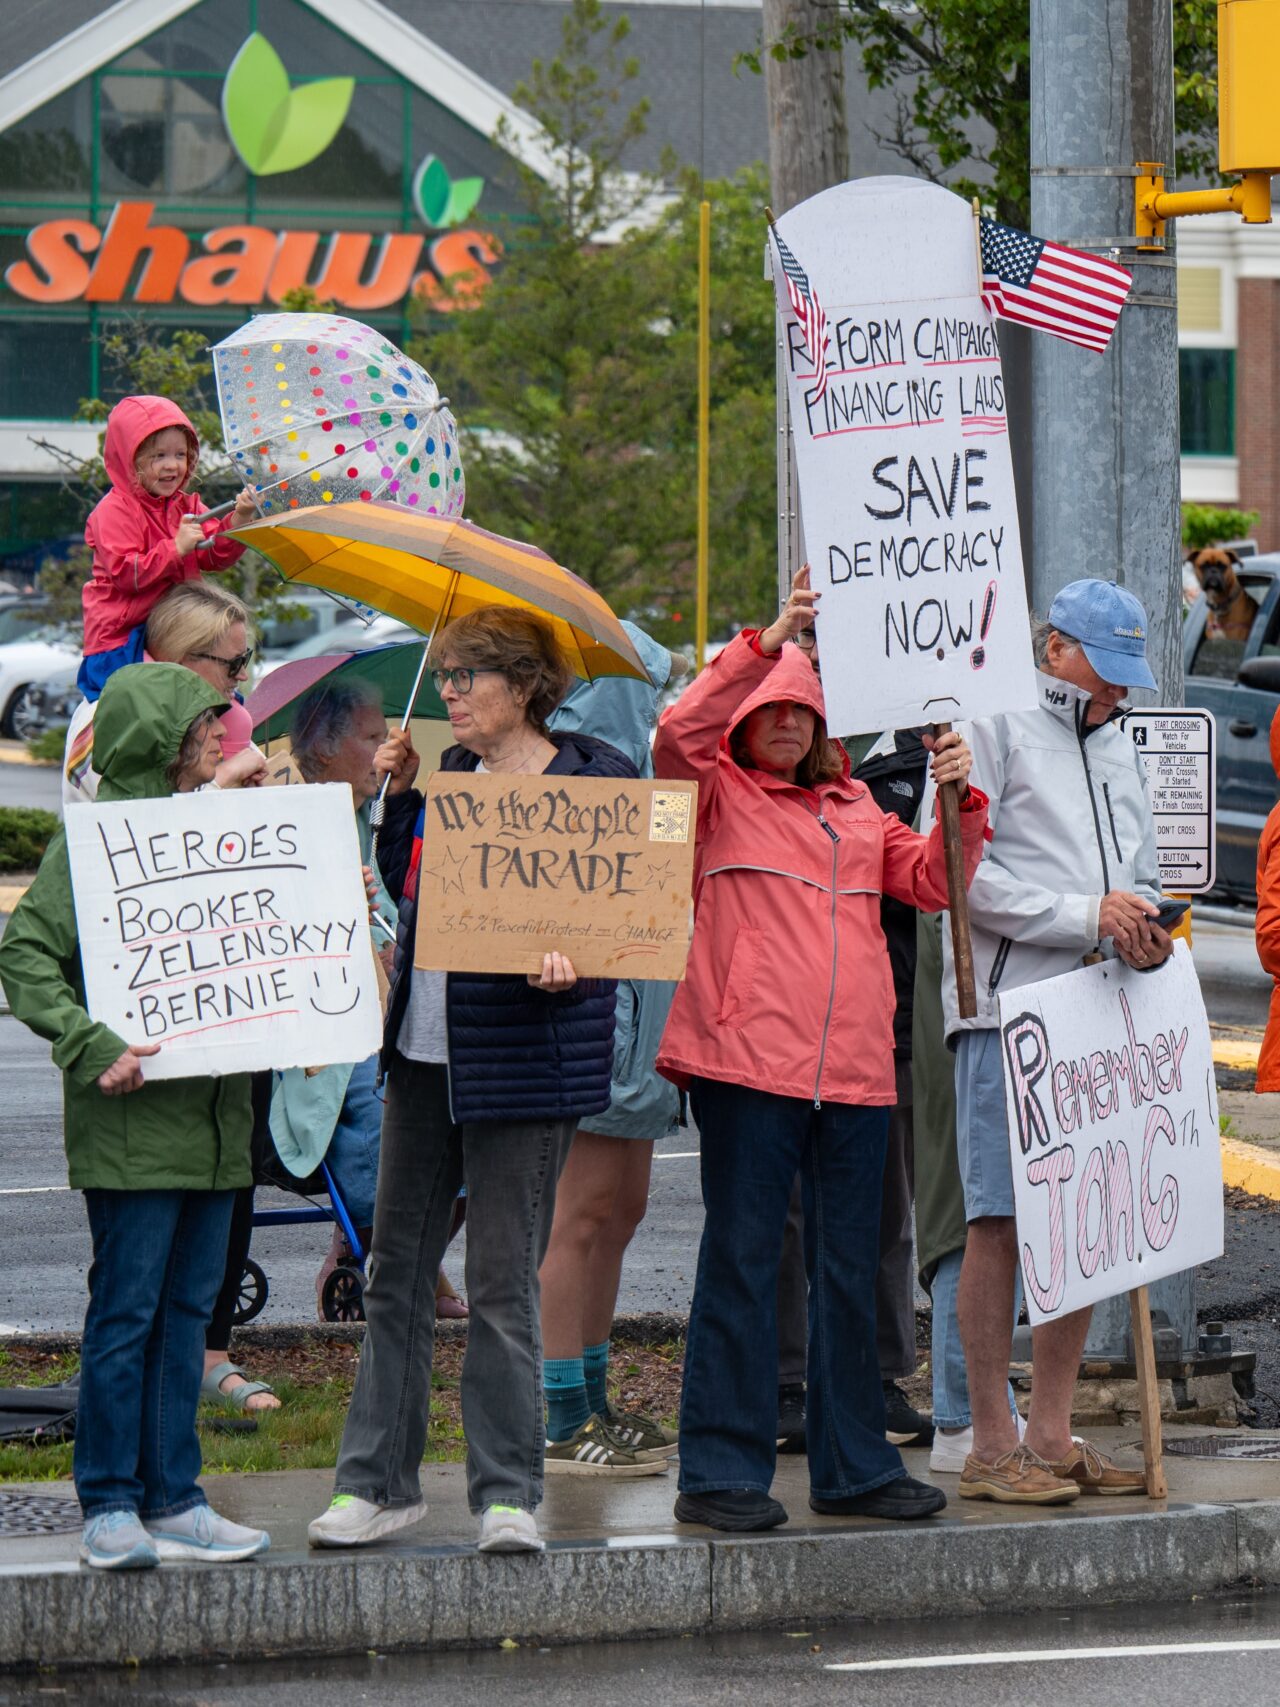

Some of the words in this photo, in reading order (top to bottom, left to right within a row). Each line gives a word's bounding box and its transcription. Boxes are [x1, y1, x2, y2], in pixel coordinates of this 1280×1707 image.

[913, 317, 1000, 362] CAMPAIGN
[803, 377, 943, 435] FINANCING
[959, 374, 1005, 416] LAWS
[864, 448, 991, 526] SAVE
[828, 526, 1004, 584] DEMOCRACY
[885, 580, 997, 670] NOW!
[1154, 721, 1169, 729] START
[1170, 721, 1201, 729] CROSSING
[1162, 732, 1178, 740] Watch
[1181, 732, 1189, 740] For
[1165, 742, 1187, 750] Vehicles
[1159, 756, 1177, 764] DON'T
[1179, 756, 1196, 764] START
[1176, 768, 1198, 778] Crossing
[434, 790, 486, 832] We
[495, 788, 540, 839] the
[538, 788, 641, 851] People
[1153, 801, 1159, 809] To
[1162, 801, 1178, 809] Finish
[1181, 801, 1203, 811] Crossing
[1154, 791, 1167, 799] TIME
[1170, 791, 1203, 799] REMAINING
[97, 818, 298, 886] HEROES
[1157, 826, 1175, 835] DON'T
[1177, 826, 1196, 835] CROSS
[470, 842, 647, 896] PARADE
[1159, 870, 1182, 878] CROSS
[1163, 853, 1190, 862] BUTTON
[117, 888, 280, 943] BOOKER
[542, 919, 592, 937] Protest
[613, 923, 677, 943] CHANGE
[128, 918, 357, 990] ZELENSKYY
[139, 968, 294, 1037] BERNIE
[1002, 987, 1189, 1154] Remember
[1023, 1139, 1134, 1313] Jan
